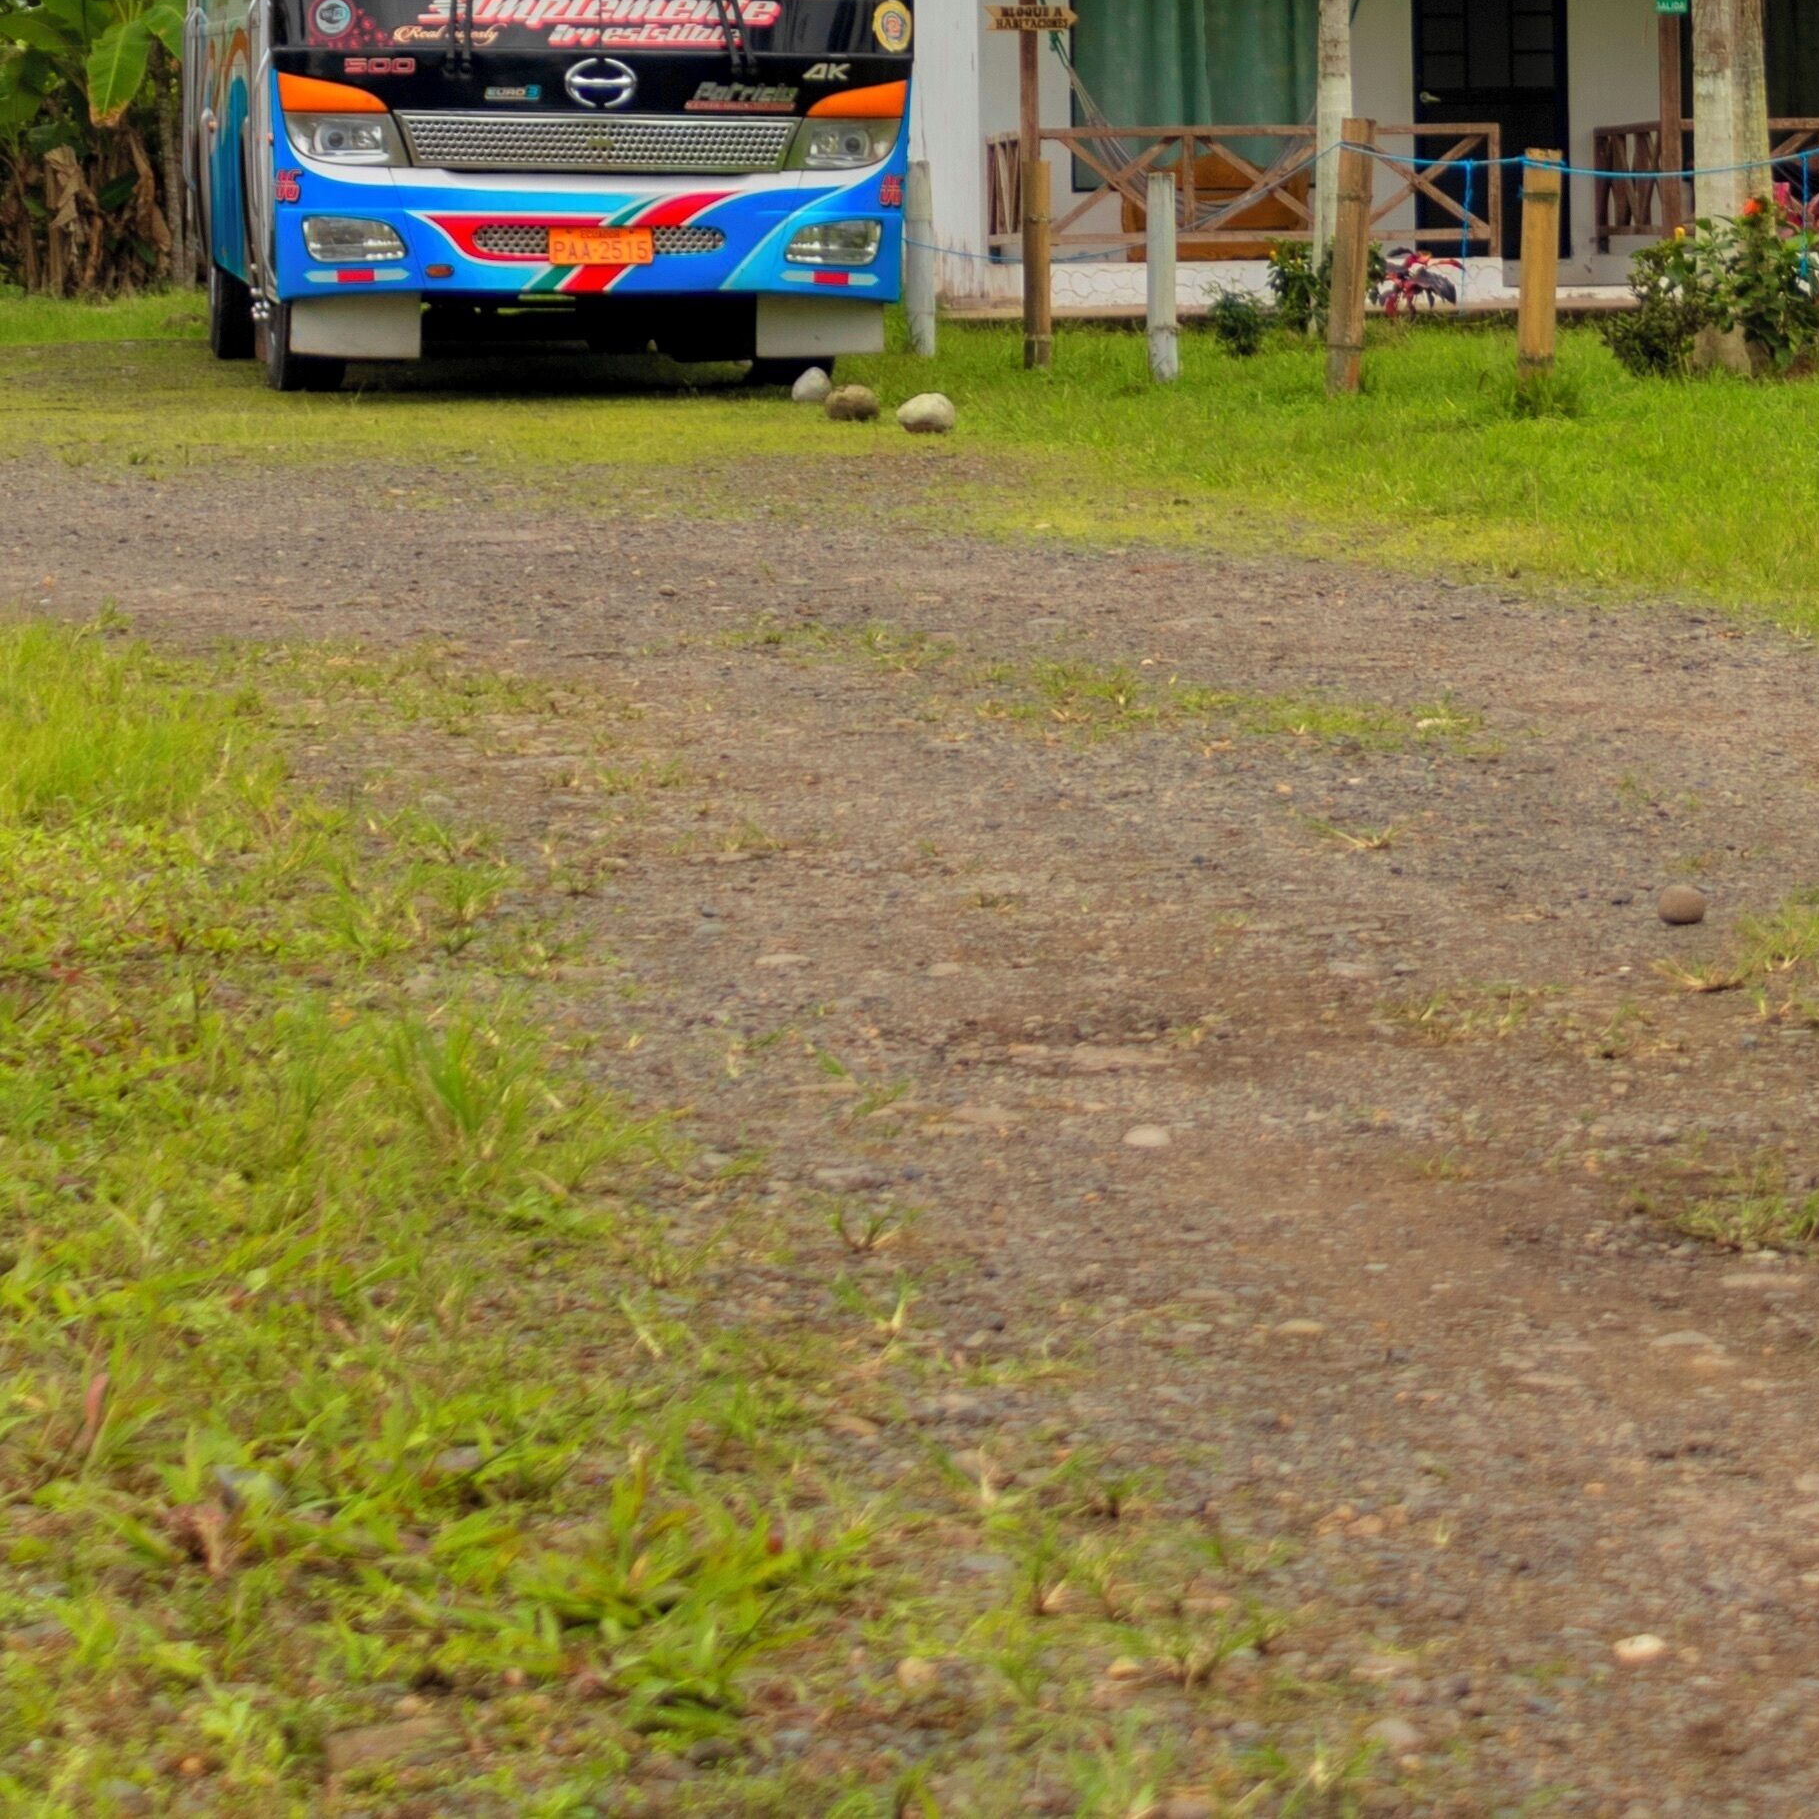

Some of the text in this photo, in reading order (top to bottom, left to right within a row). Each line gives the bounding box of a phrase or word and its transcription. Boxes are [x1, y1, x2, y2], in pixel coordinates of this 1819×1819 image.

[1054, 6, 1063, 18] A
[1656, 0, 1687, 13] SALIDA
[343, 57, 416, 74] 500
[803, 63, 850, 80] AK
[554, 240, 649, 261] PAA-2515
